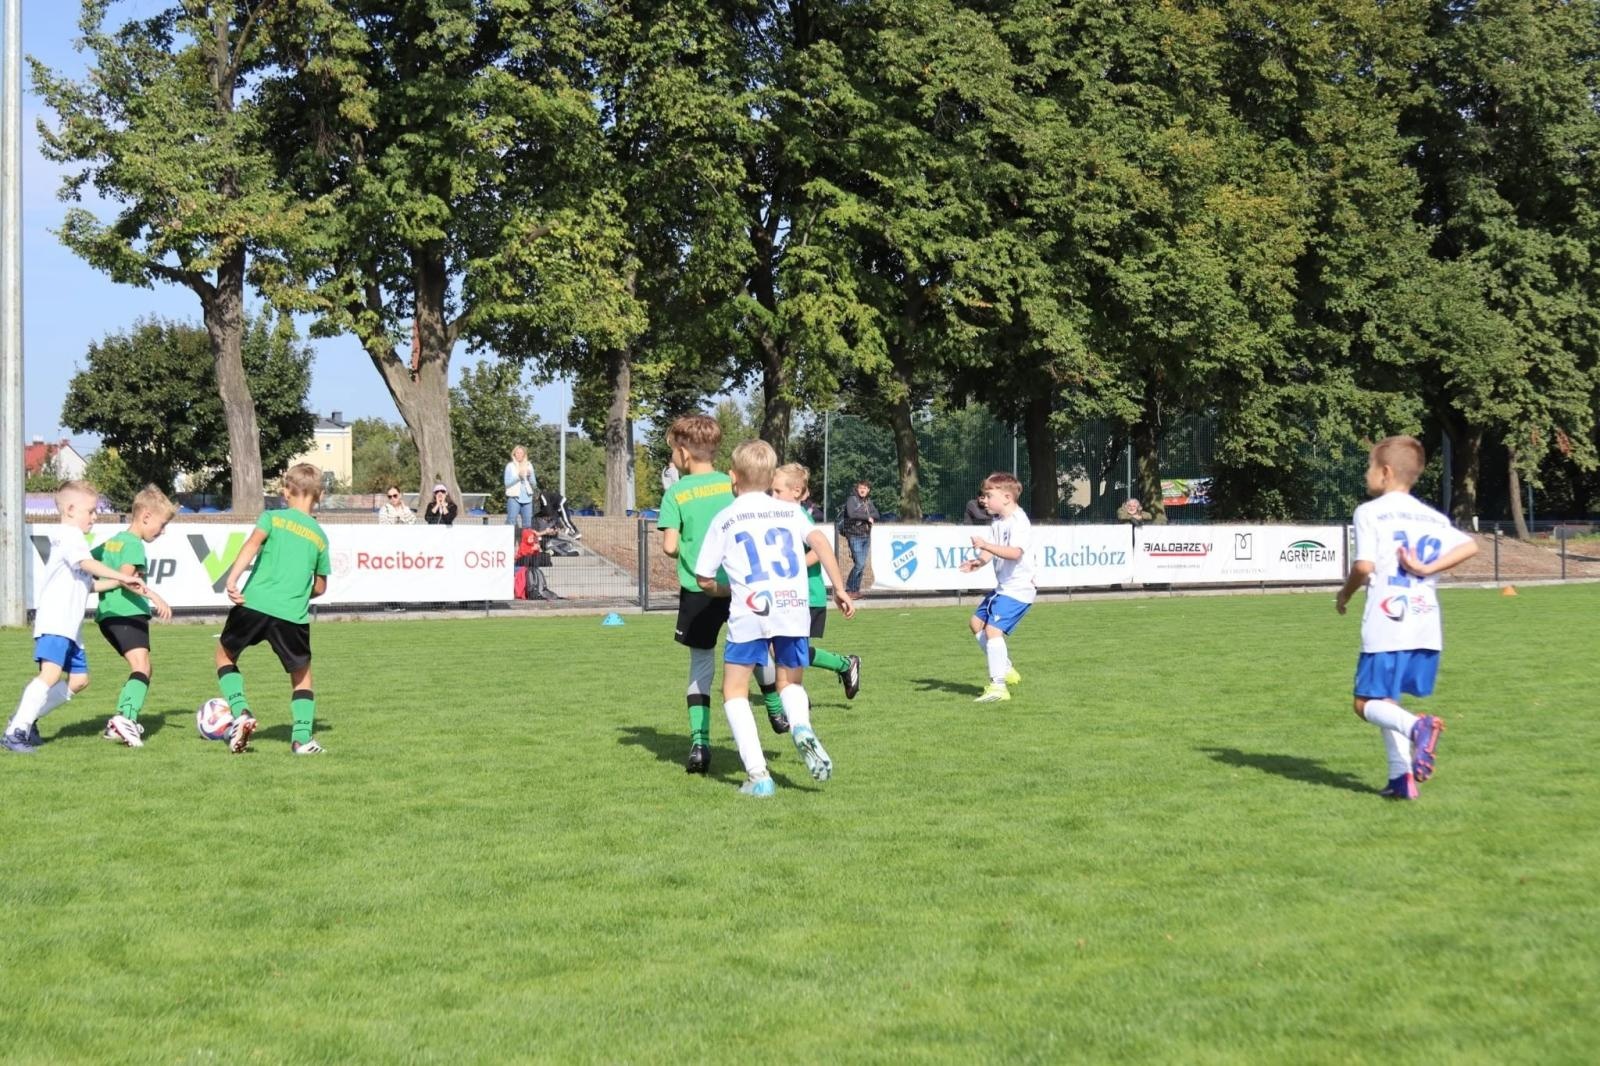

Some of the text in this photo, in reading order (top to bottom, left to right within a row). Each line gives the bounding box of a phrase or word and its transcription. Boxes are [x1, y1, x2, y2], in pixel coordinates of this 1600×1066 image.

[357, 551, 506, 570] Racibórz OSiR
[735, 527, 800, 584] 13
[1044, 545, 1126, 567] Racibórz
[775, 590, 798, 599] PRO
